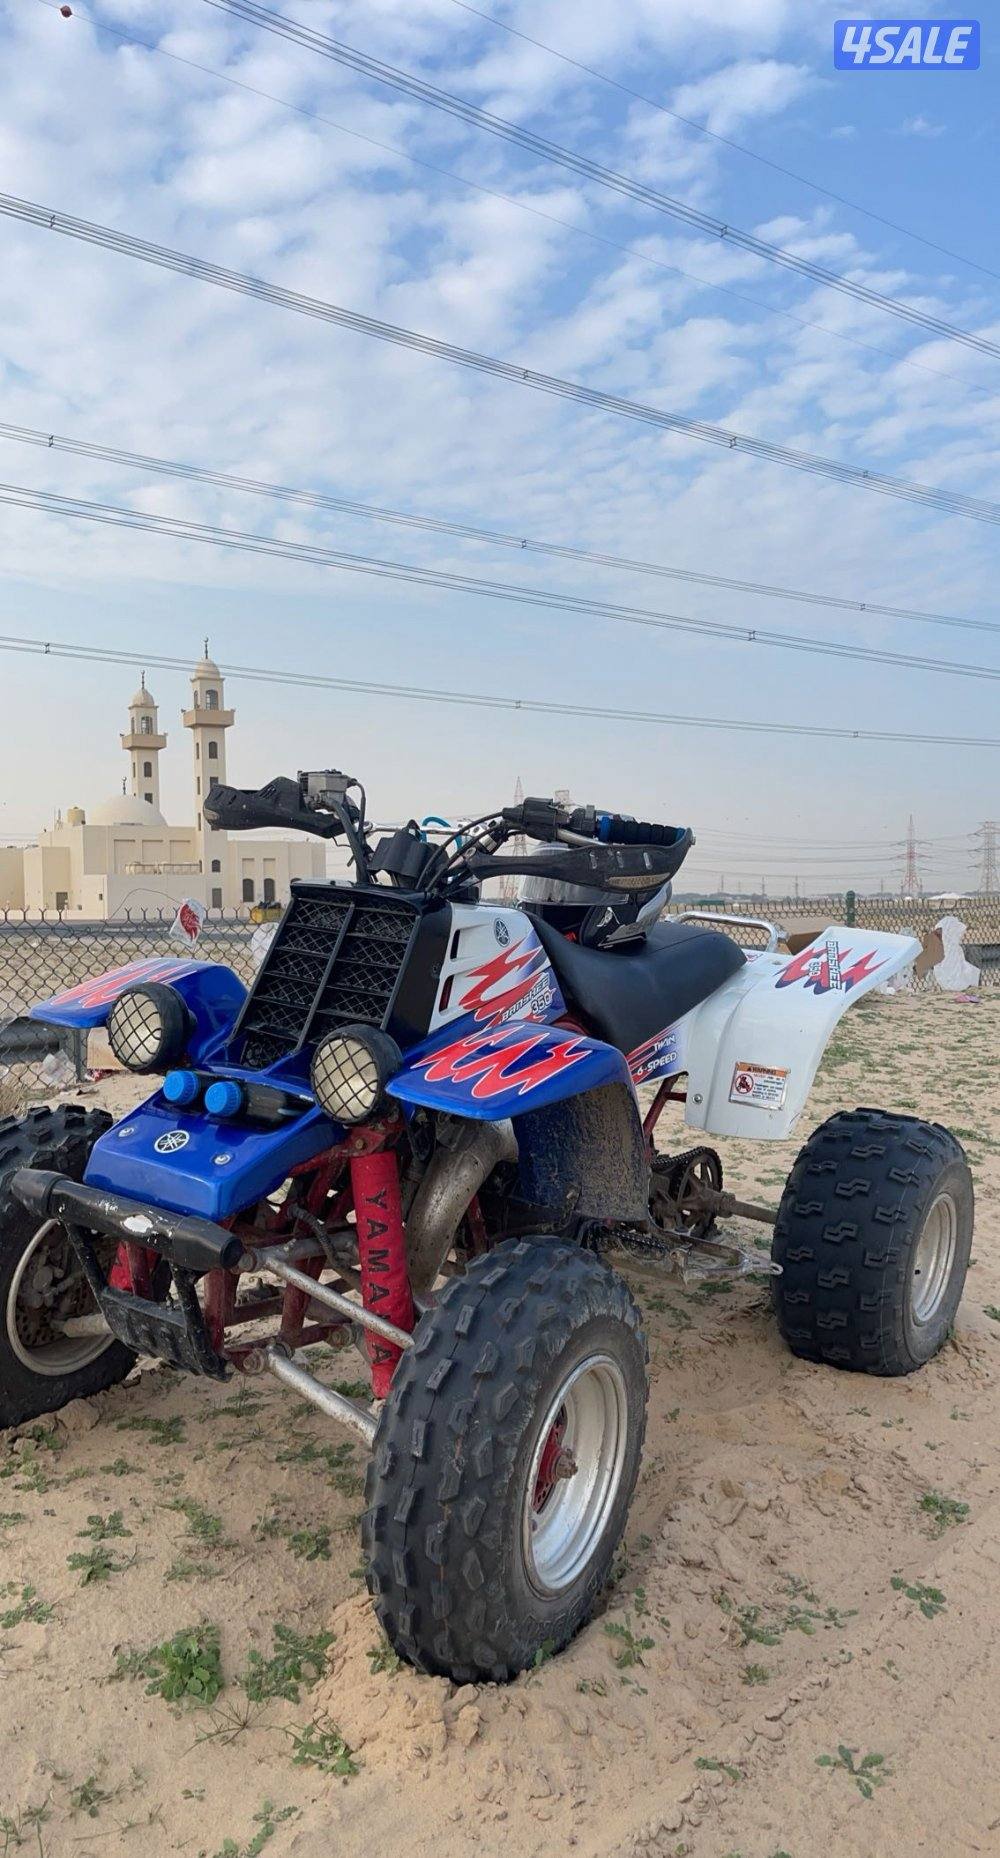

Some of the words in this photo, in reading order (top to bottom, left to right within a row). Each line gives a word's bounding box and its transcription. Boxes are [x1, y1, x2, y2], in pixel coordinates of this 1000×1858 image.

[531, 989, 552, 1015] 350
[654, 1035, 676, 1051] TWIN
[637, 1052, 677, 1076] 6-SPEED
[365, 1188, 392, 1364] YAMAA
